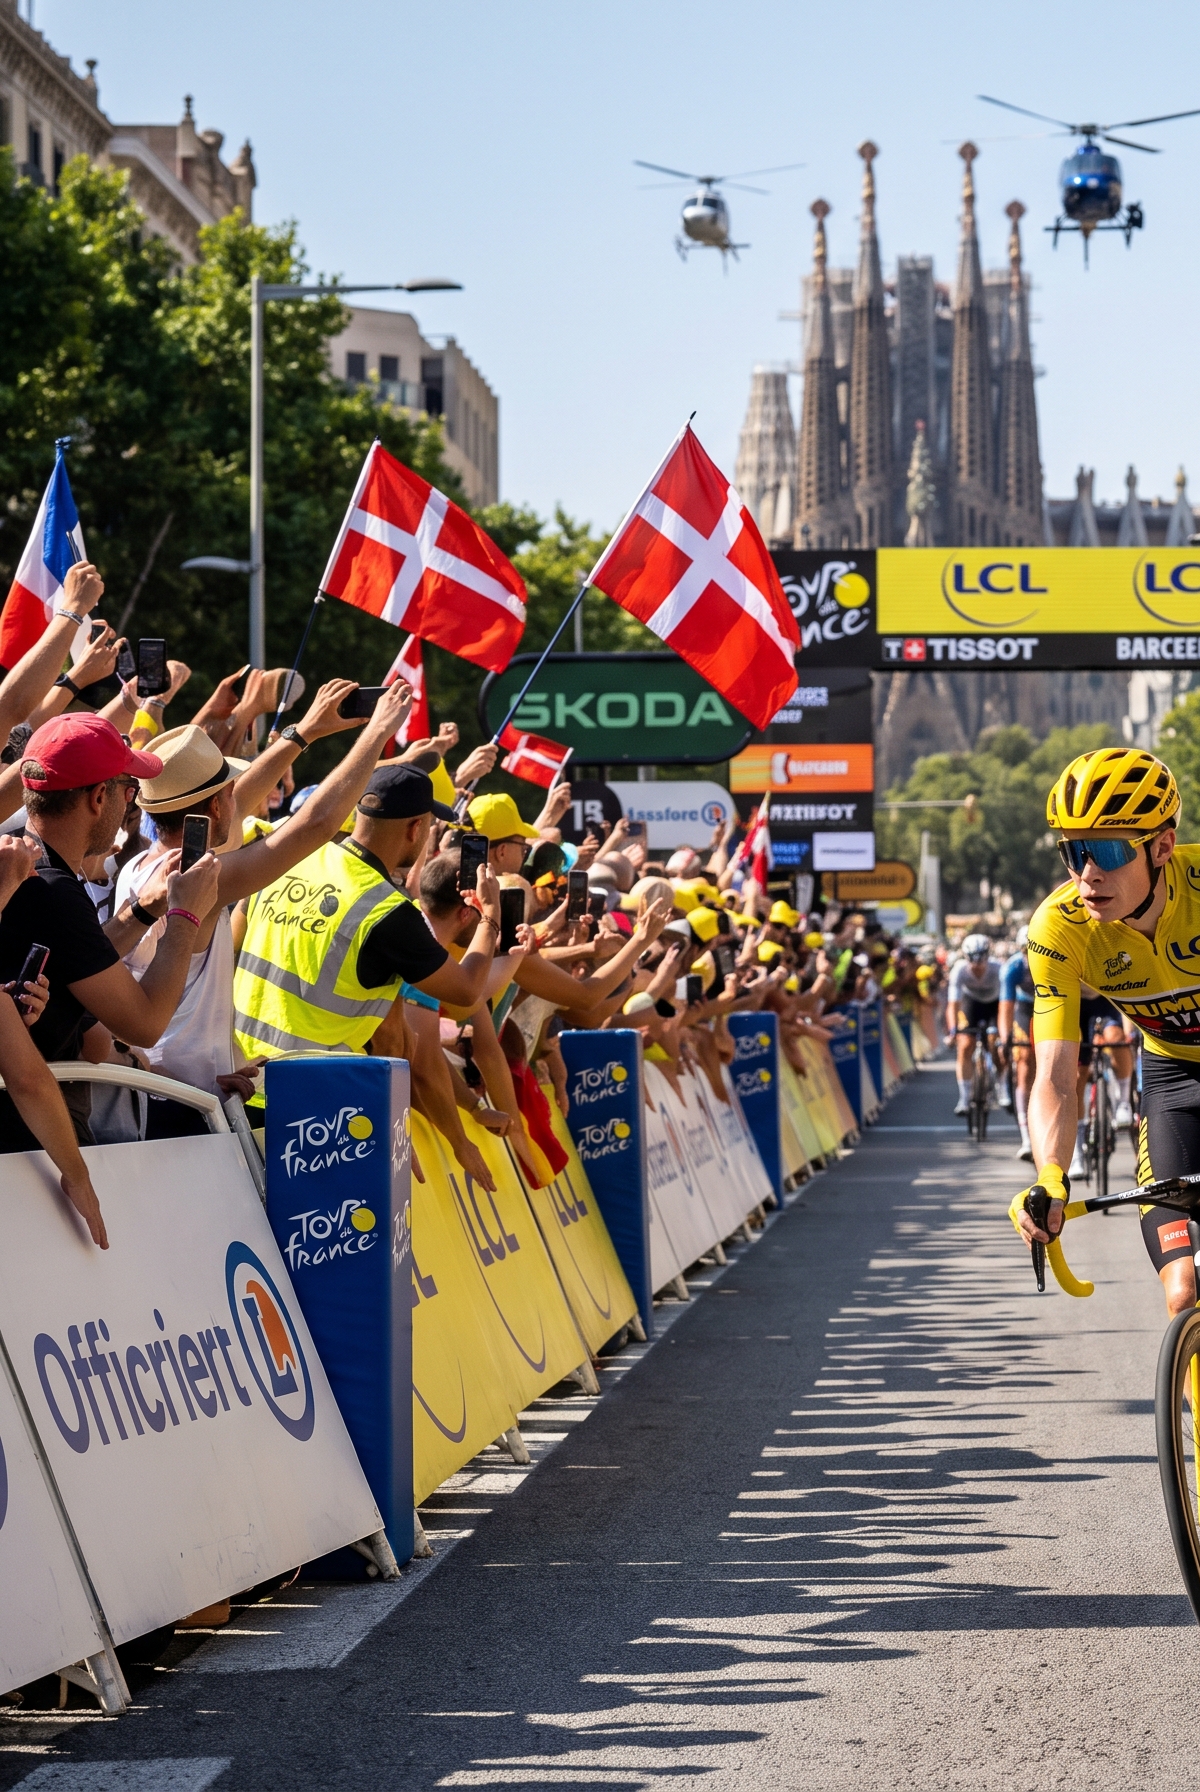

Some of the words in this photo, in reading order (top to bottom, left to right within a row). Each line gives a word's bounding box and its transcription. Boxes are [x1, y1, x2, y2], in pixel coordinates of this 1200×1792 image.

[954, 562, 1048, 594] LCL
[802, 608, 869, 648] nce
[929, 638, 1038, 661] TISSOT
[509, 691, 733, 729] SKODA
[1059, 895, 1085, 915] LC
[33, 1308, 253, 1454] Officriert
